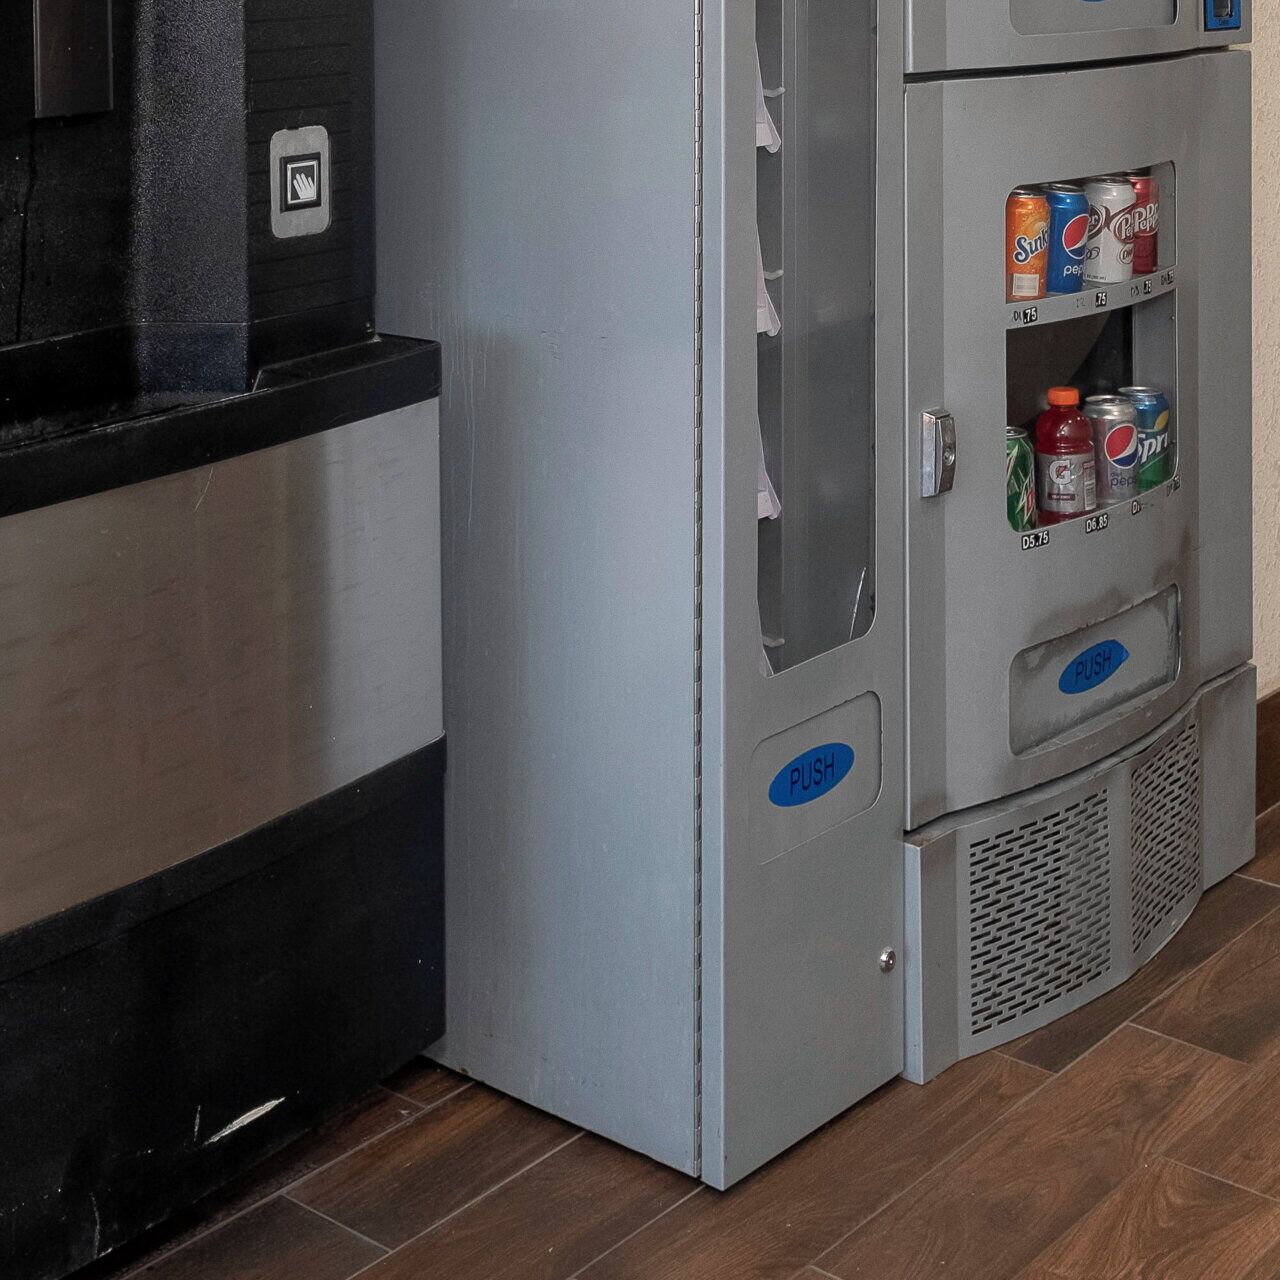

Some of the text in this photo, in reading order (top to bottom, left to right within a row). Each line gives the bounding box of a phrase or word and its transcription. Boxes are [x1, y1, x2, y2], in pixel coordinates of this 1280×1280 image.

[1023, 307, 1037, 323] .75
[1095, 292, 1107, 307] .75
[1075, 647, 1111, 686] PUSH
[790, 751, 835, 797] PUSH
